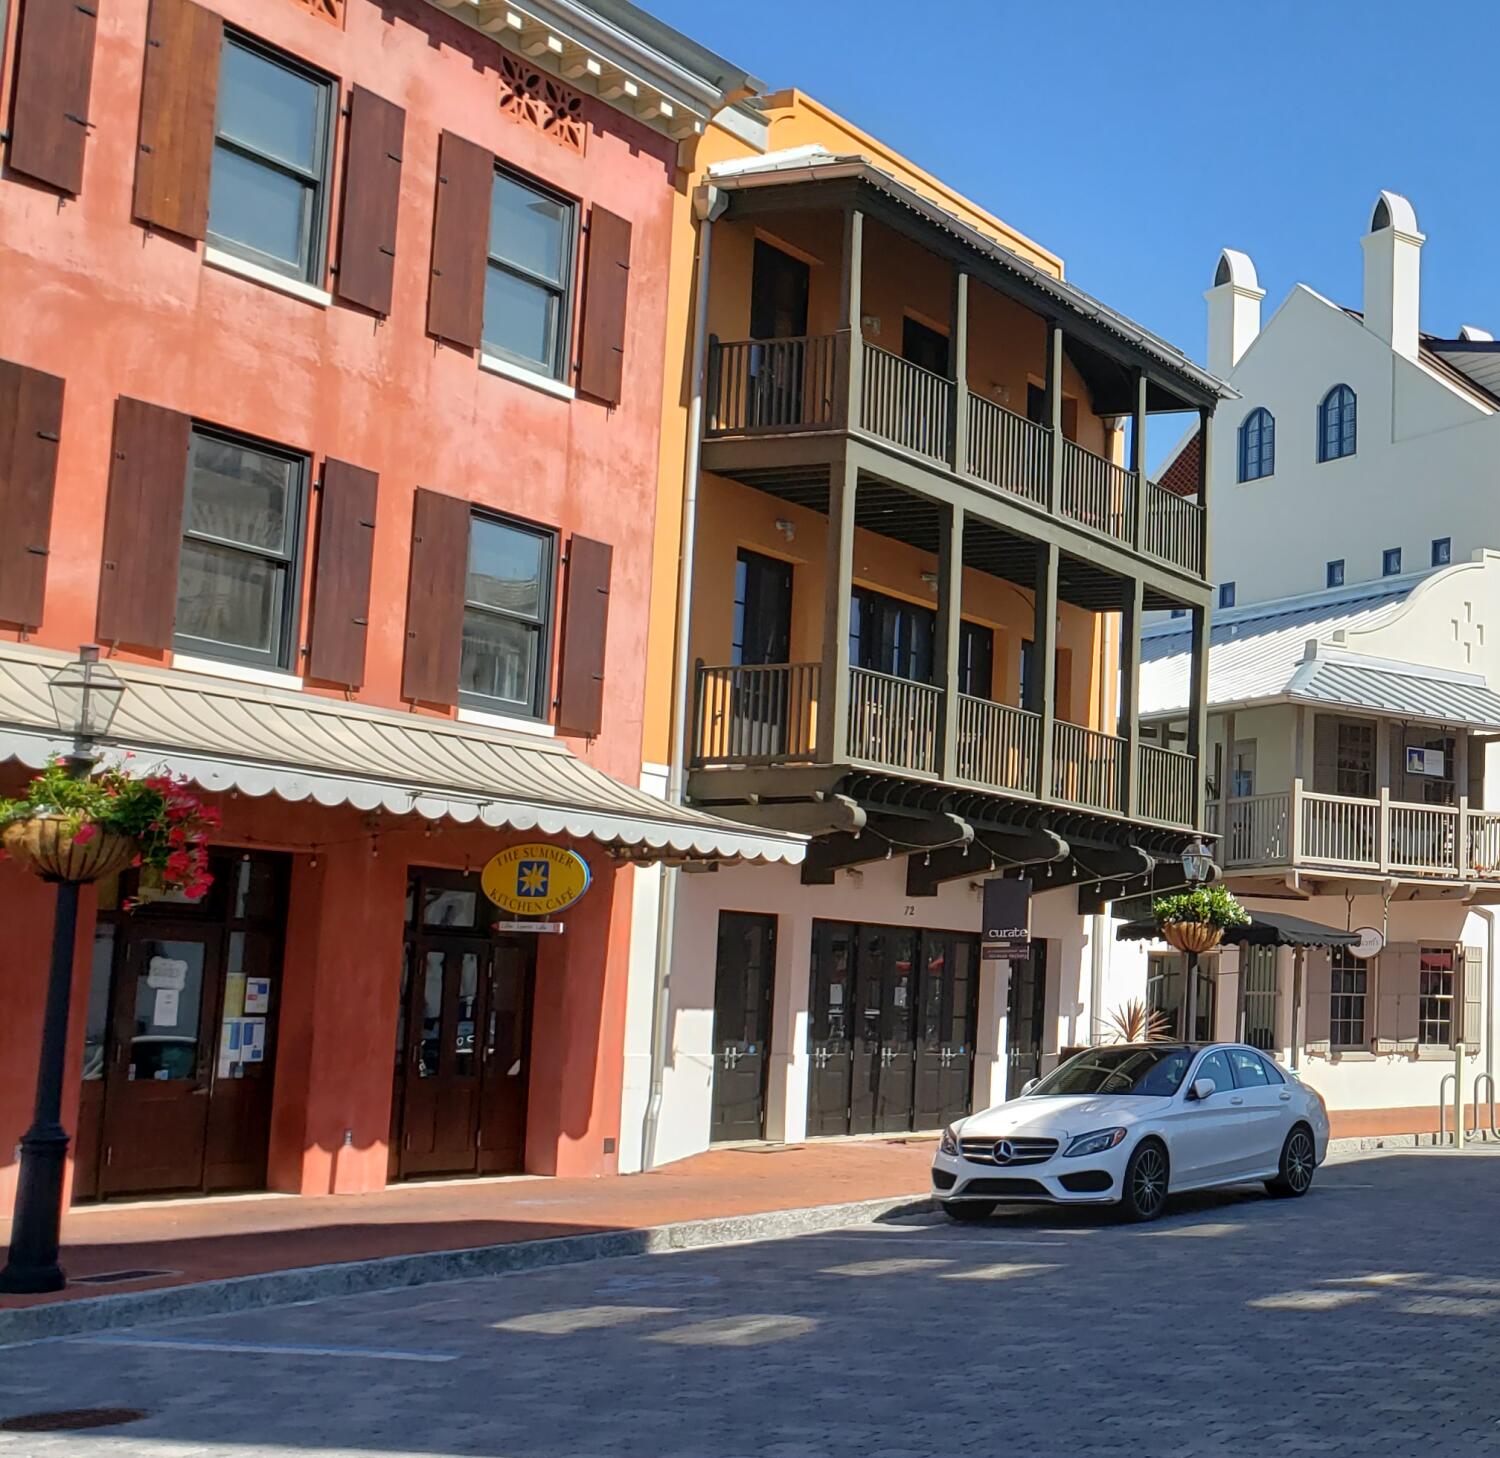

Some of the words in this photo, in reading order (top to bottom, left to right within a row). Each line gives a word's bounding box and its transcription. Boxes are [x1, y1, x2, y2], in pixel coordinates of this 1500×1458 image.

[497, 849, 520, 866] THE
[522, 847, 574, 868] SUMMER
[489, 887, 543, 913] KITCHEN
[904, 906, 915, 915] 72
[989, 927, 1028, 938] curate
